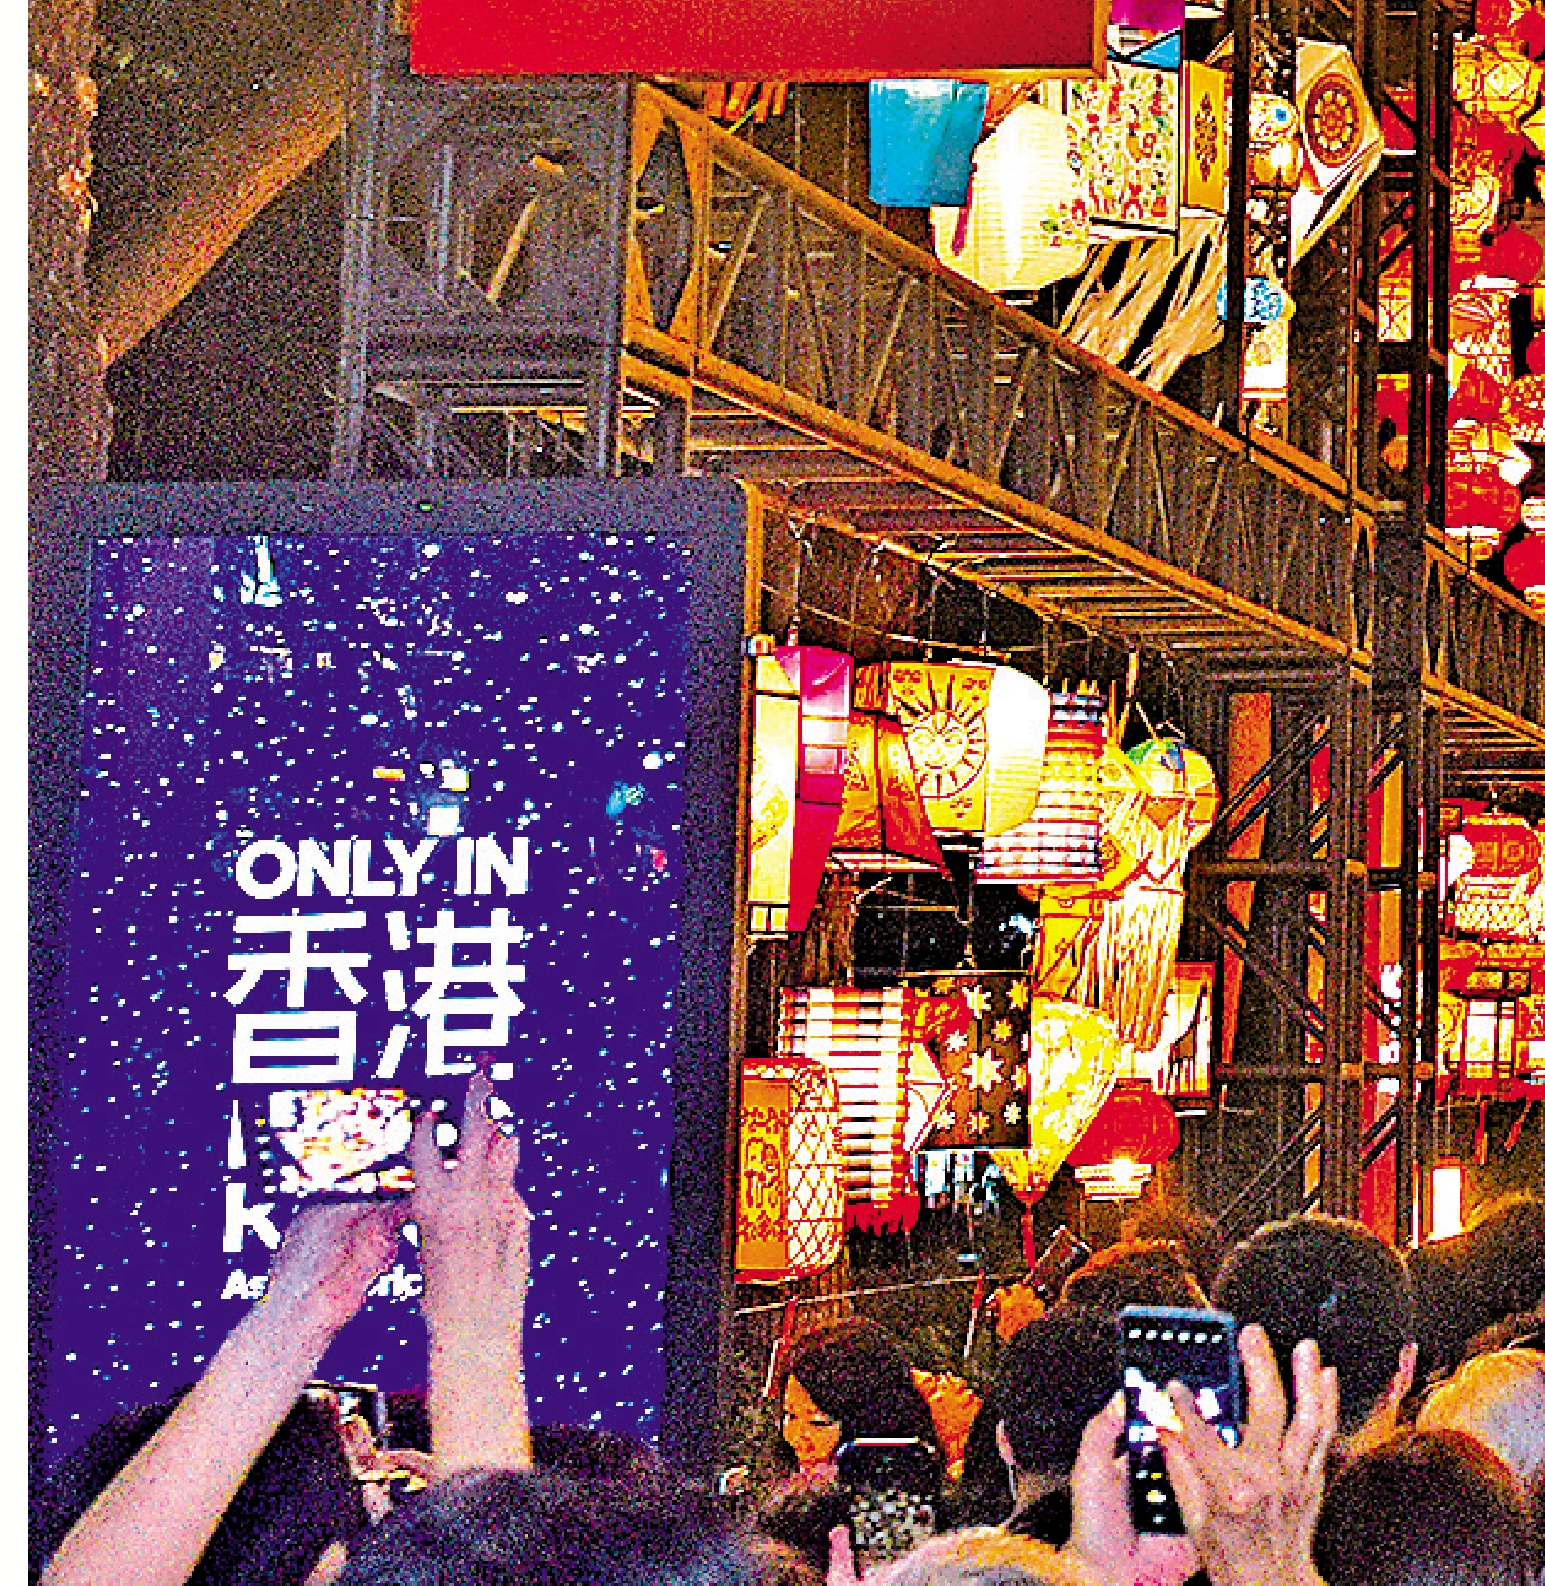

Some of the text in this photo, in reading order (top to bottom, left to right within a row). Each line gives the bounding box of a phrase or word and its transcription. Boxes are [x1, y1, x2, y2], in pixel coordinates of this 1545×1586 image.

[234, 830, 530, 901] ONLY IN
[221, 906, 527, 1085] 香港
